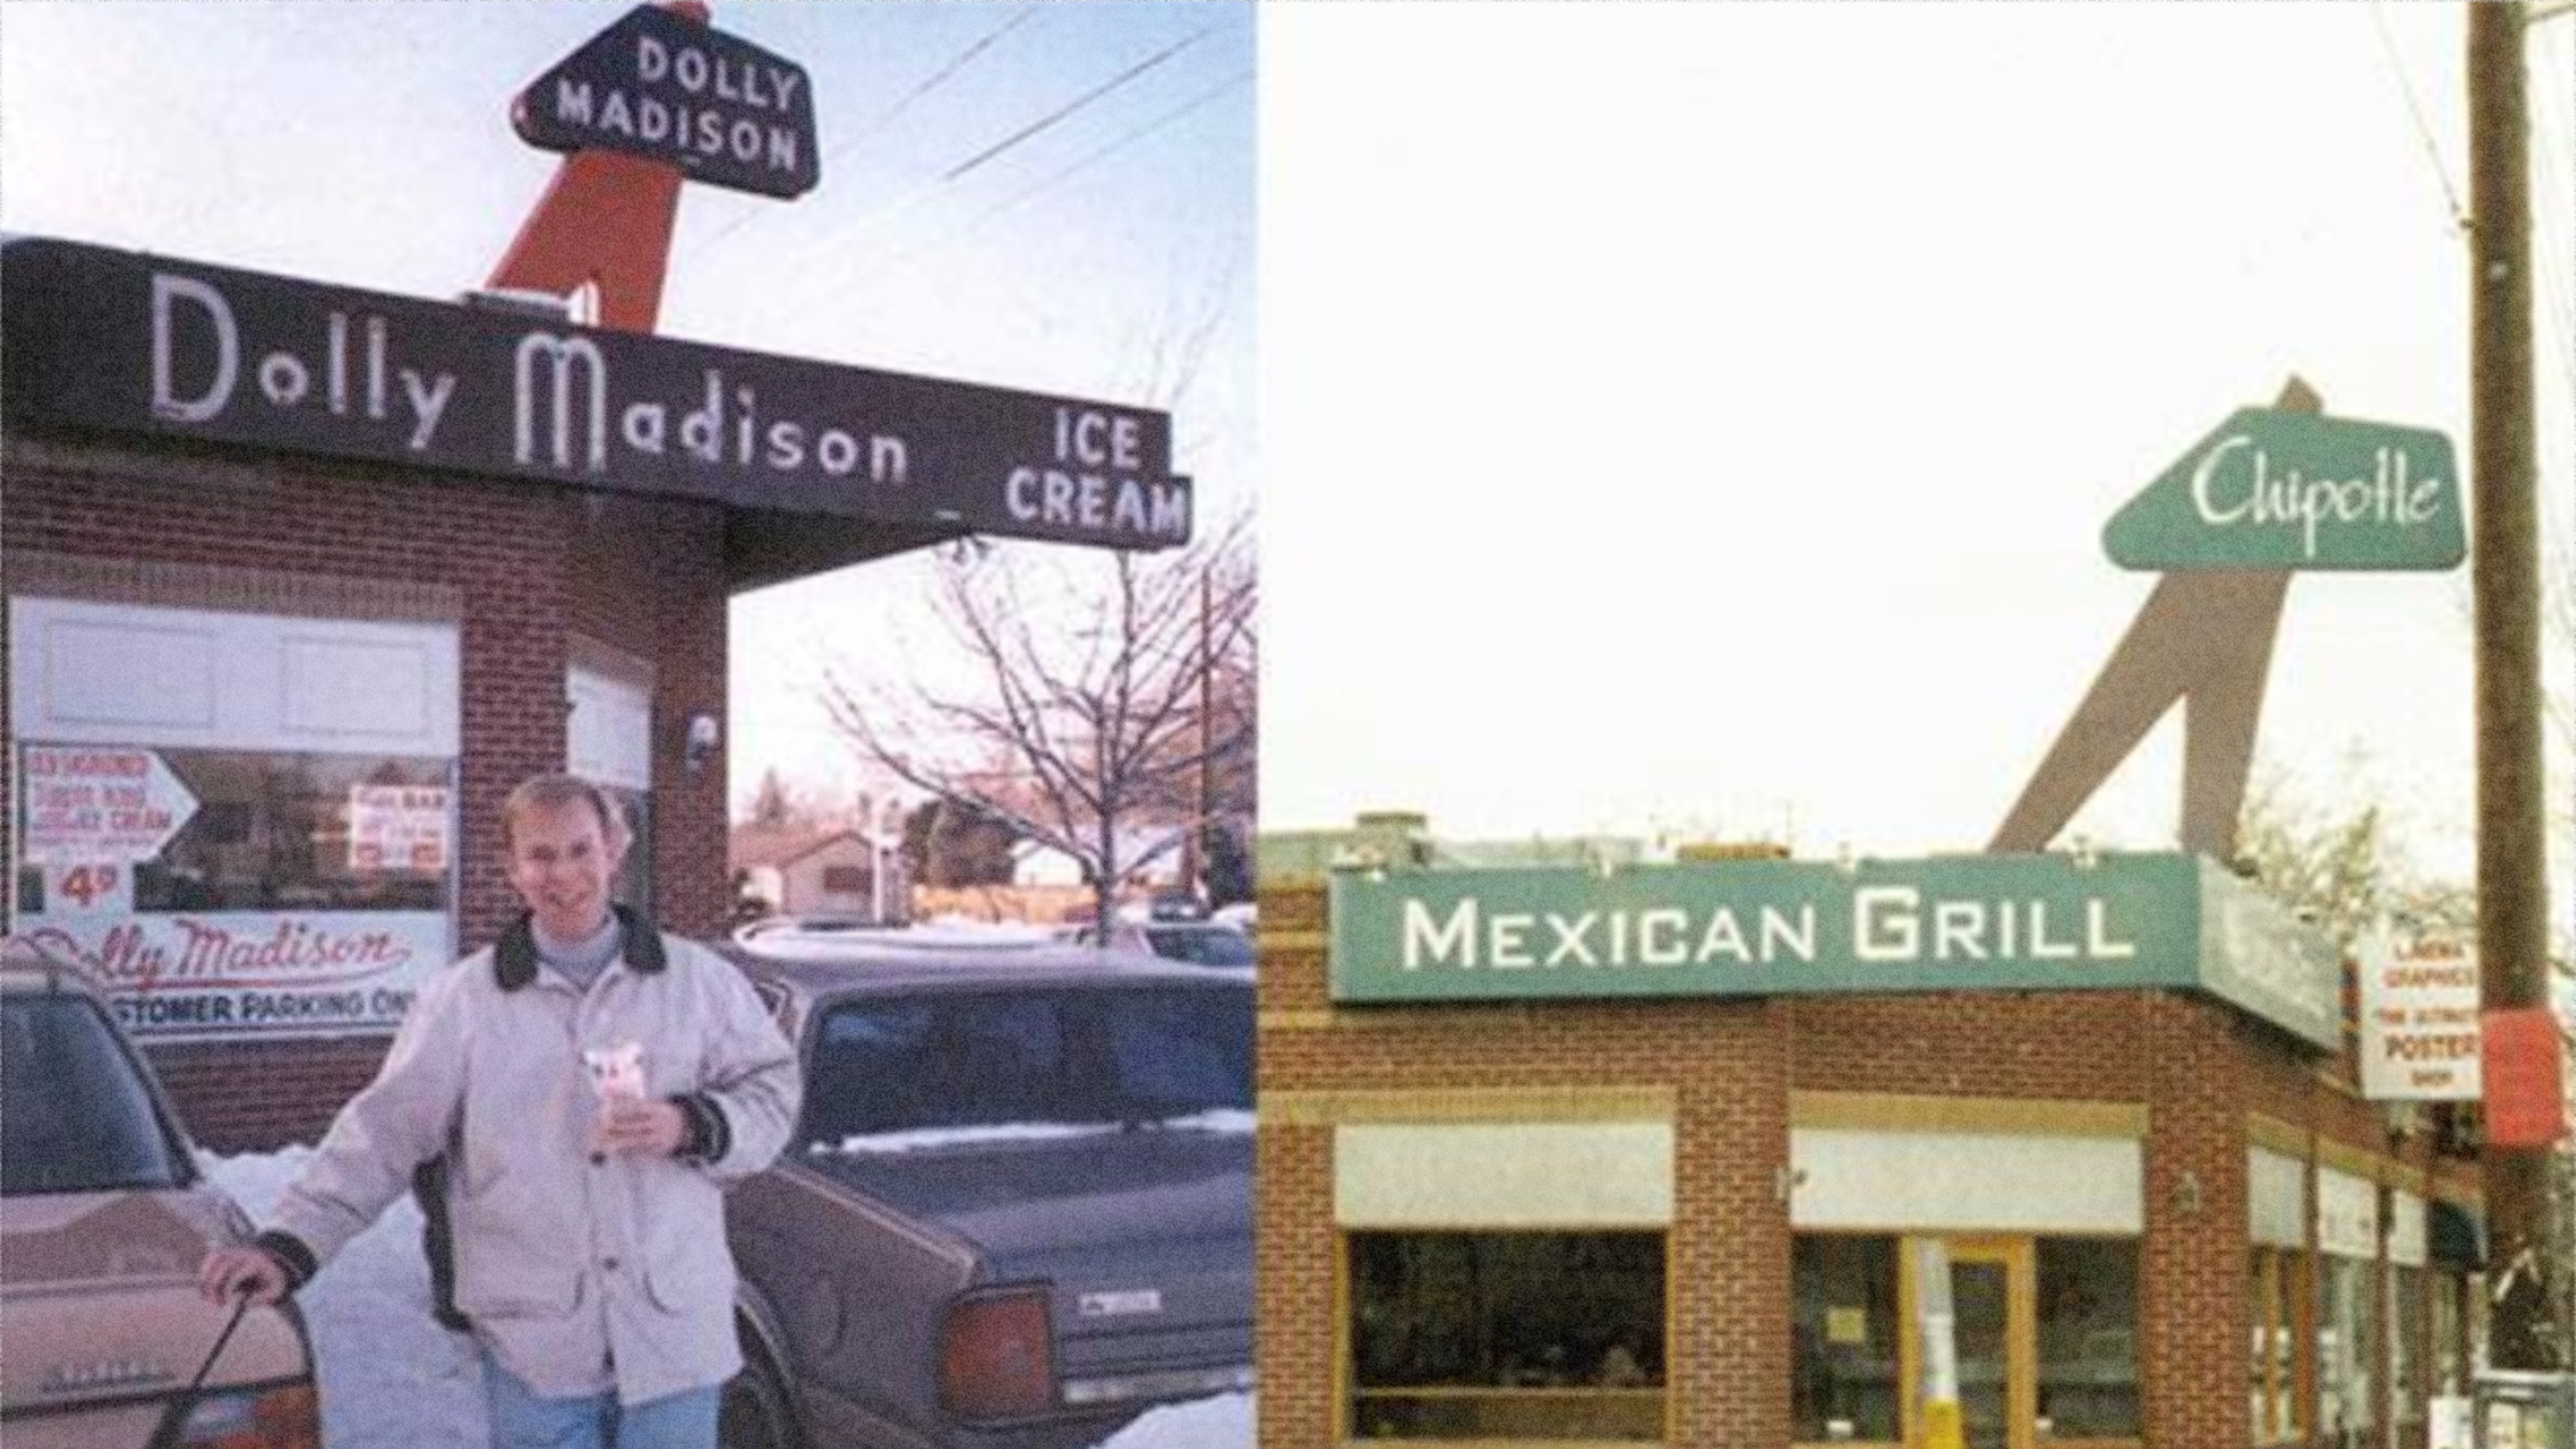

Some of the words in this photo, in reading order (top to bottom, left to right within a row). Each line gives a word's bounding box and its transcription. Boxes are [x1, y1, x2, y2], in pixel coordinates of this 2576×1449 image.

[639, 37, 798, 110] DOLLY
[556, 80, 796, 170] MADISON
[152, 274, 456, 450] Dolly
[515, 332, 908, 484] Madison
[1054, 407, 1140, 468] ICE
[1007, 467, 1186, 535] CREAM
[2191, 435, 2440, 558] Chipotle
[174, 918, 411, 977] Madison
[1403, 896, 1817, 969] MEXICAN
[1854, 885, 2135, 961] GRILL
[240, 990, 365, 1020] PARKING
